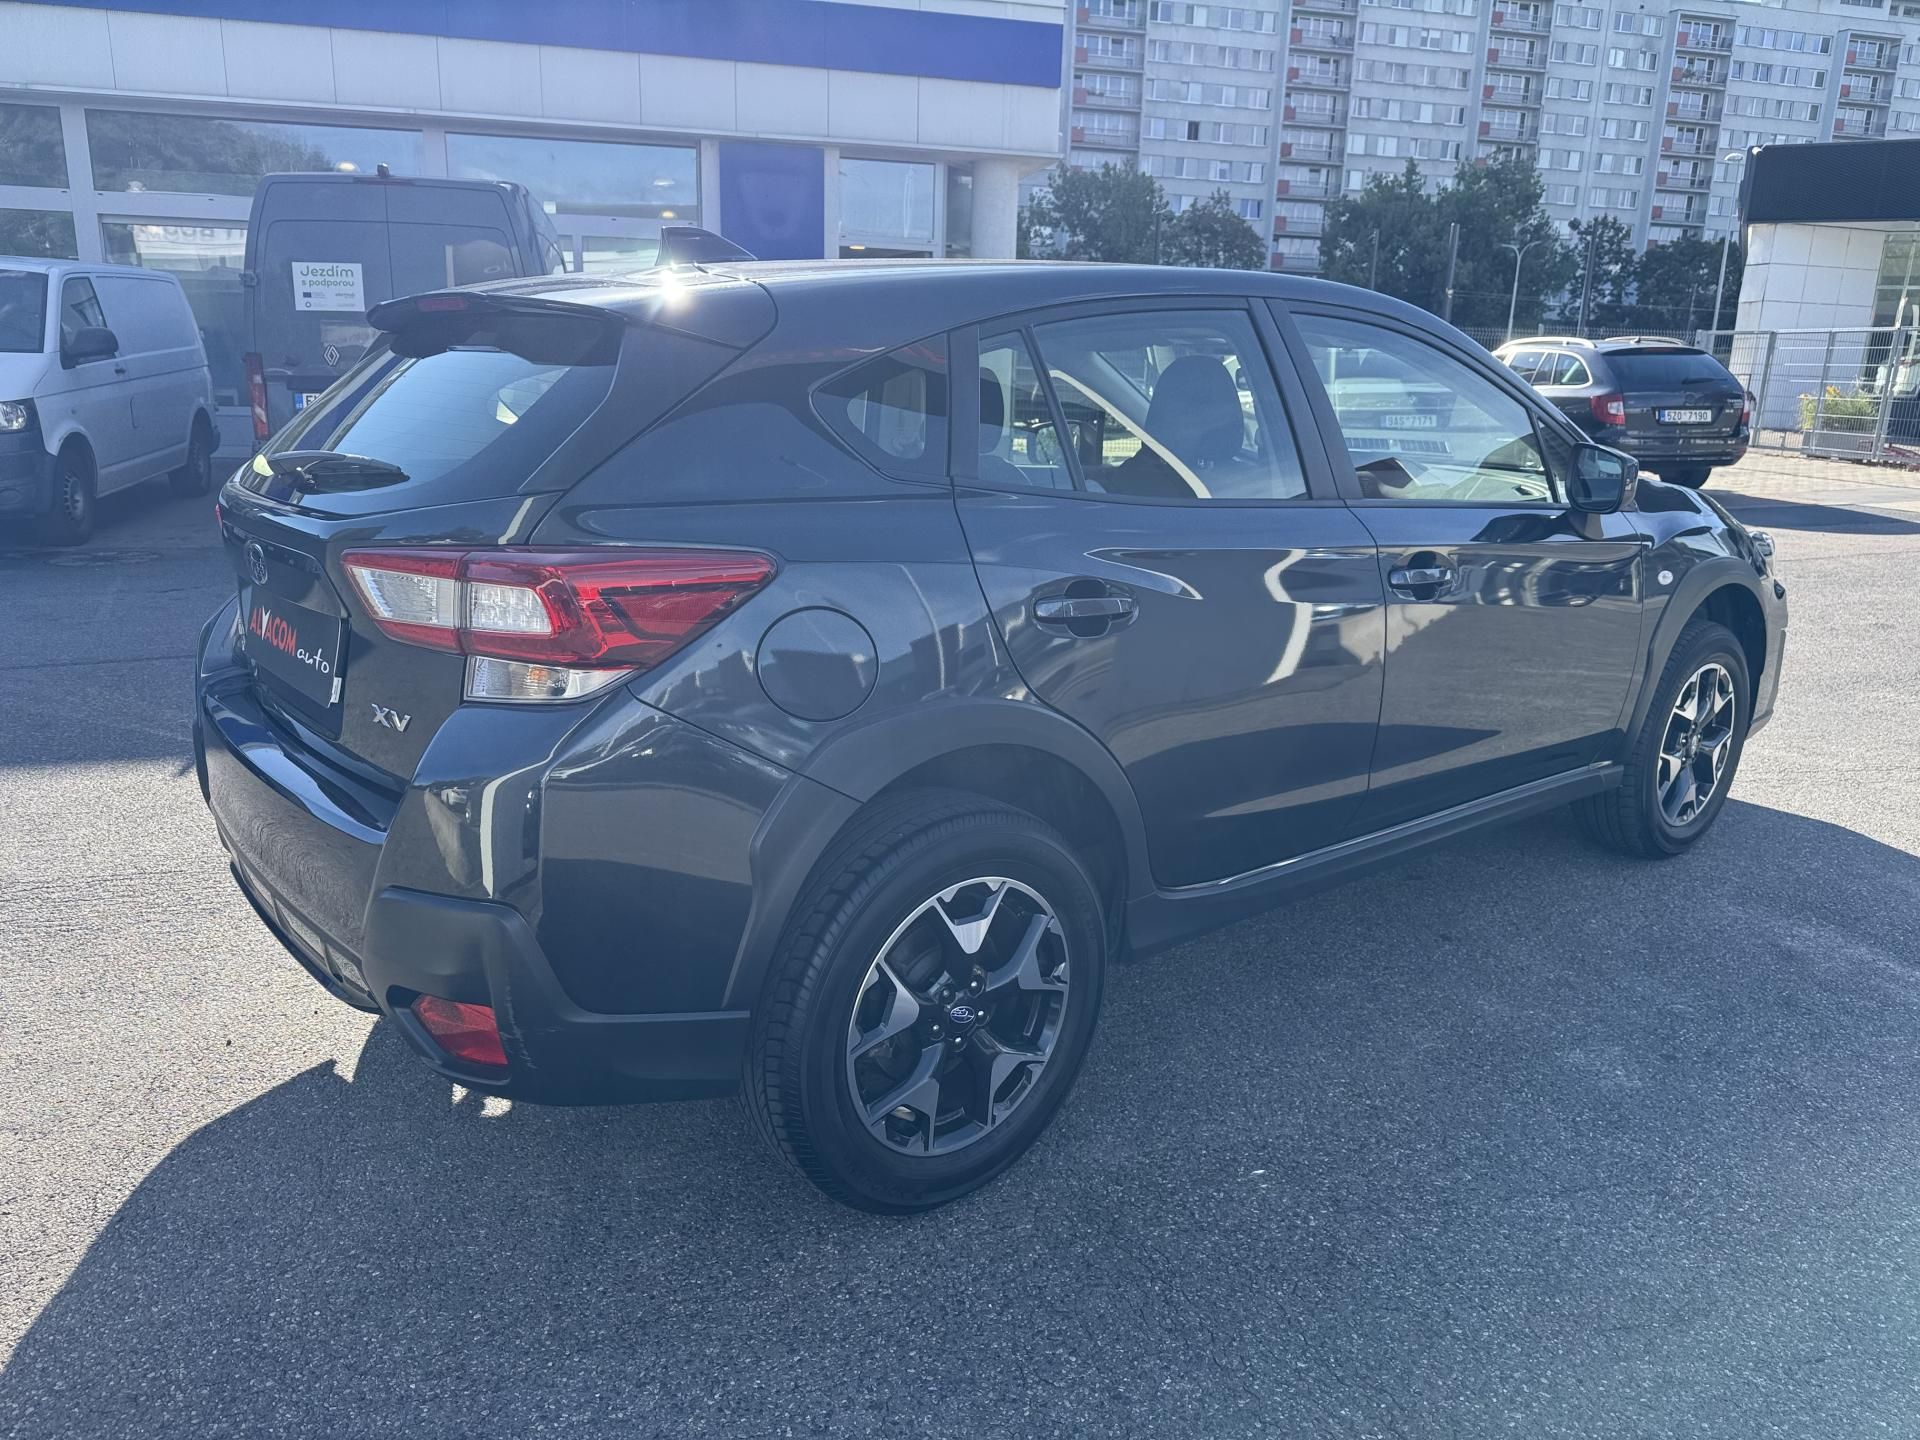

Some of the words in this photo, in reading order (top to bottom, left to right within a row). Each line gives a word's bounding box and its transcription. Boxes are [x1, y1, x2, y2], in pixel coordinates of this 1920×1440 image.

[300, 265, 354, 278] Jezdím
[308, 278, 355, 288] podporou
[1688, 411, 1708, 421] 7190
[296, 648, 330, 674] auto
[371, 703, 412, 733] XV
